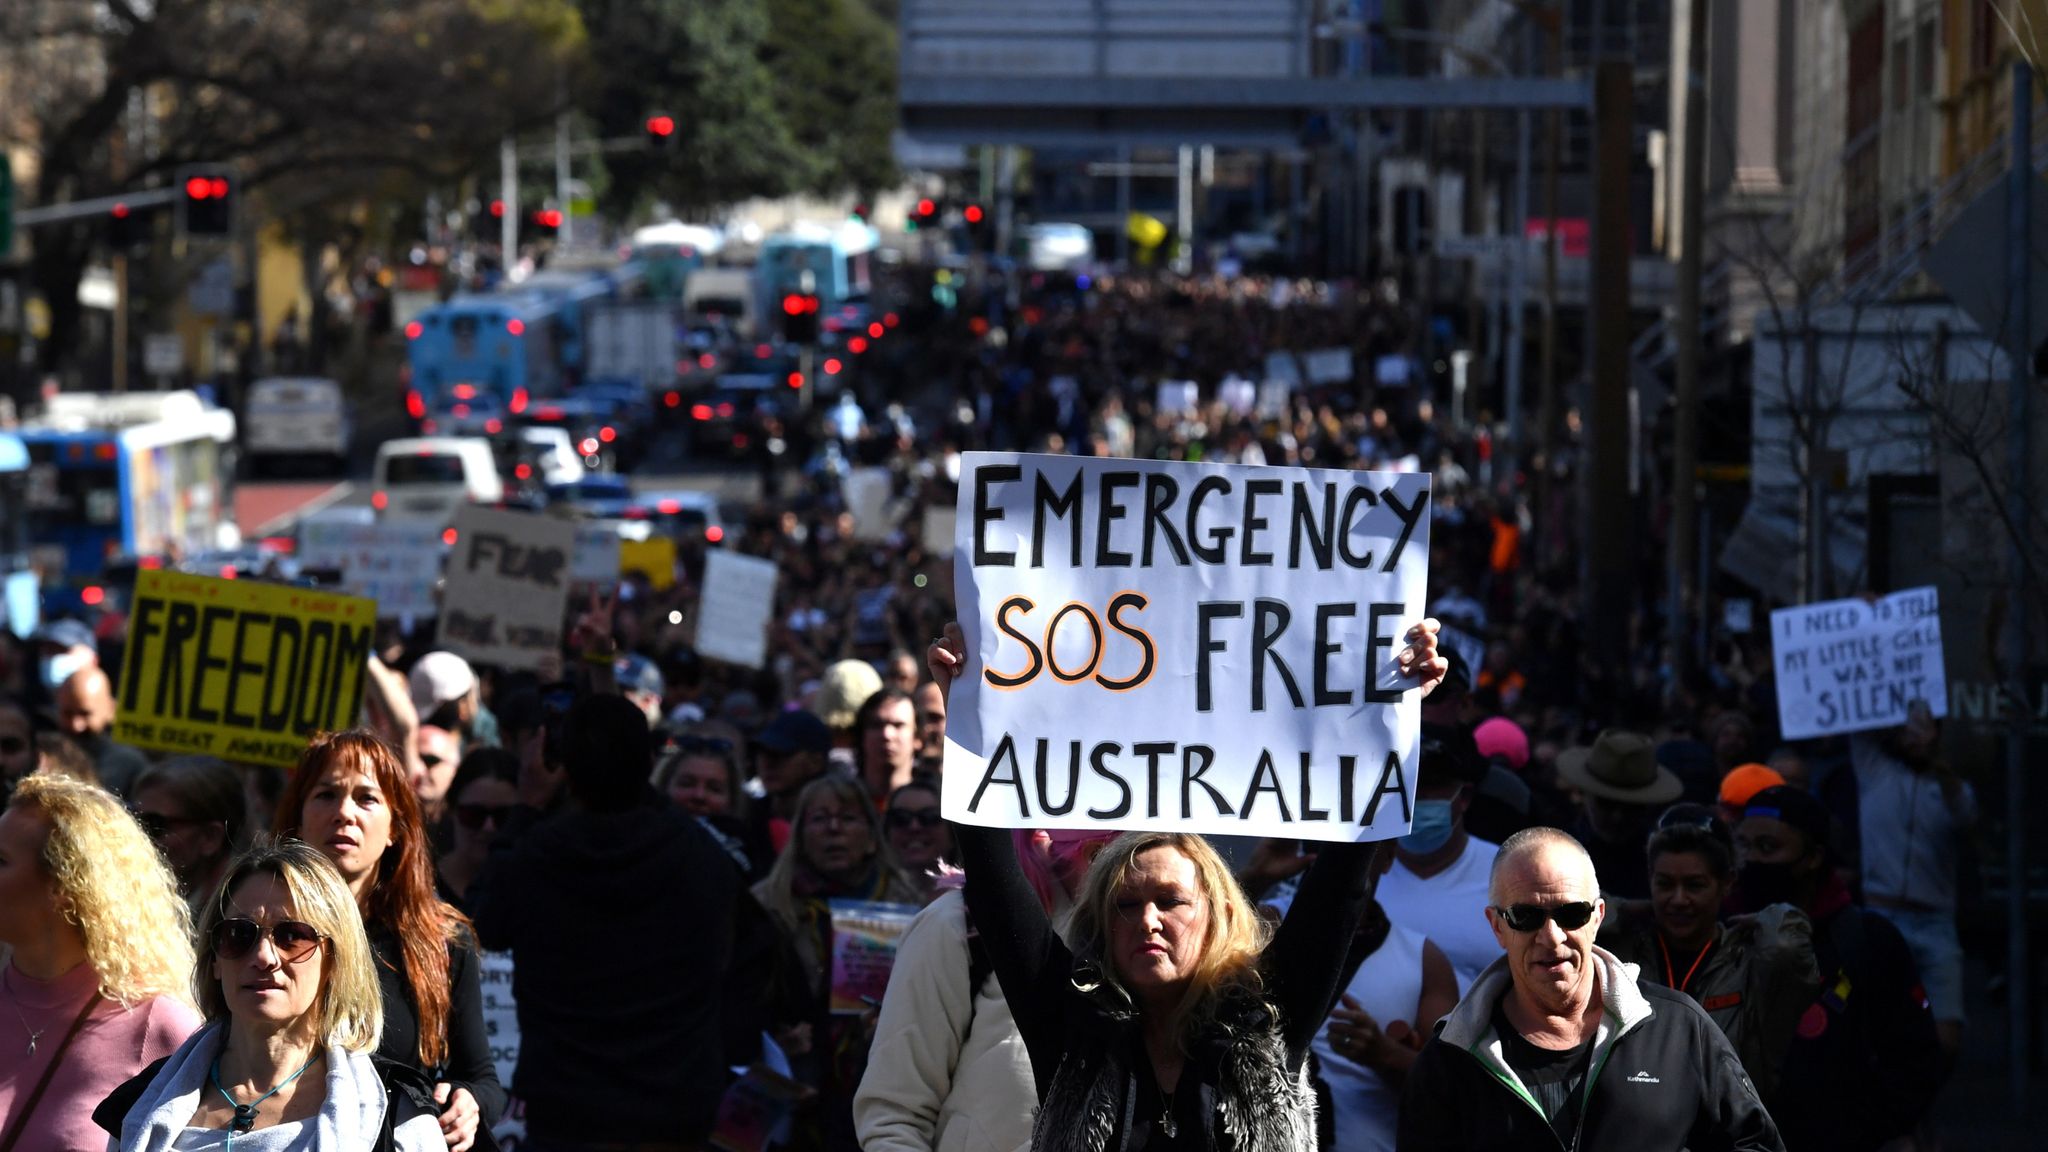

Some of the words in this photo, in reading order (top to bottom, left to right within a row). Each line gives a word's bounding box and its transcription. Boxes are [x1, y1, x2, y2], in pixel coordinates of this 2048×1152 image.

[973, 464, 1429, 573] EMERGENCY
[1784, 617, 1791, 639] I
[1805, 608, 1860, 635] NEED
[1870, 602, 1892, 621] TO
[1898, 592, 1937, 618] TELL
[124, 597, 373, 736] FREEDOM
[984, 590, 1158, 692] SOS
[1195, 597, 1405, 711] FREE
[1785, 648, 1809, 672] MY
[1819, 635, 1882, 665] LITTLE
[1803, 675, 1811, 693] I
[1833, 662, 1885, 684] WAS
[1893, 653, 1923, 673] NOT
[1816, 677, 1926, 727] SILENT
[121, 722, 154, 739] THE
[967, 731, 1411, 826] AUSTRALIA
